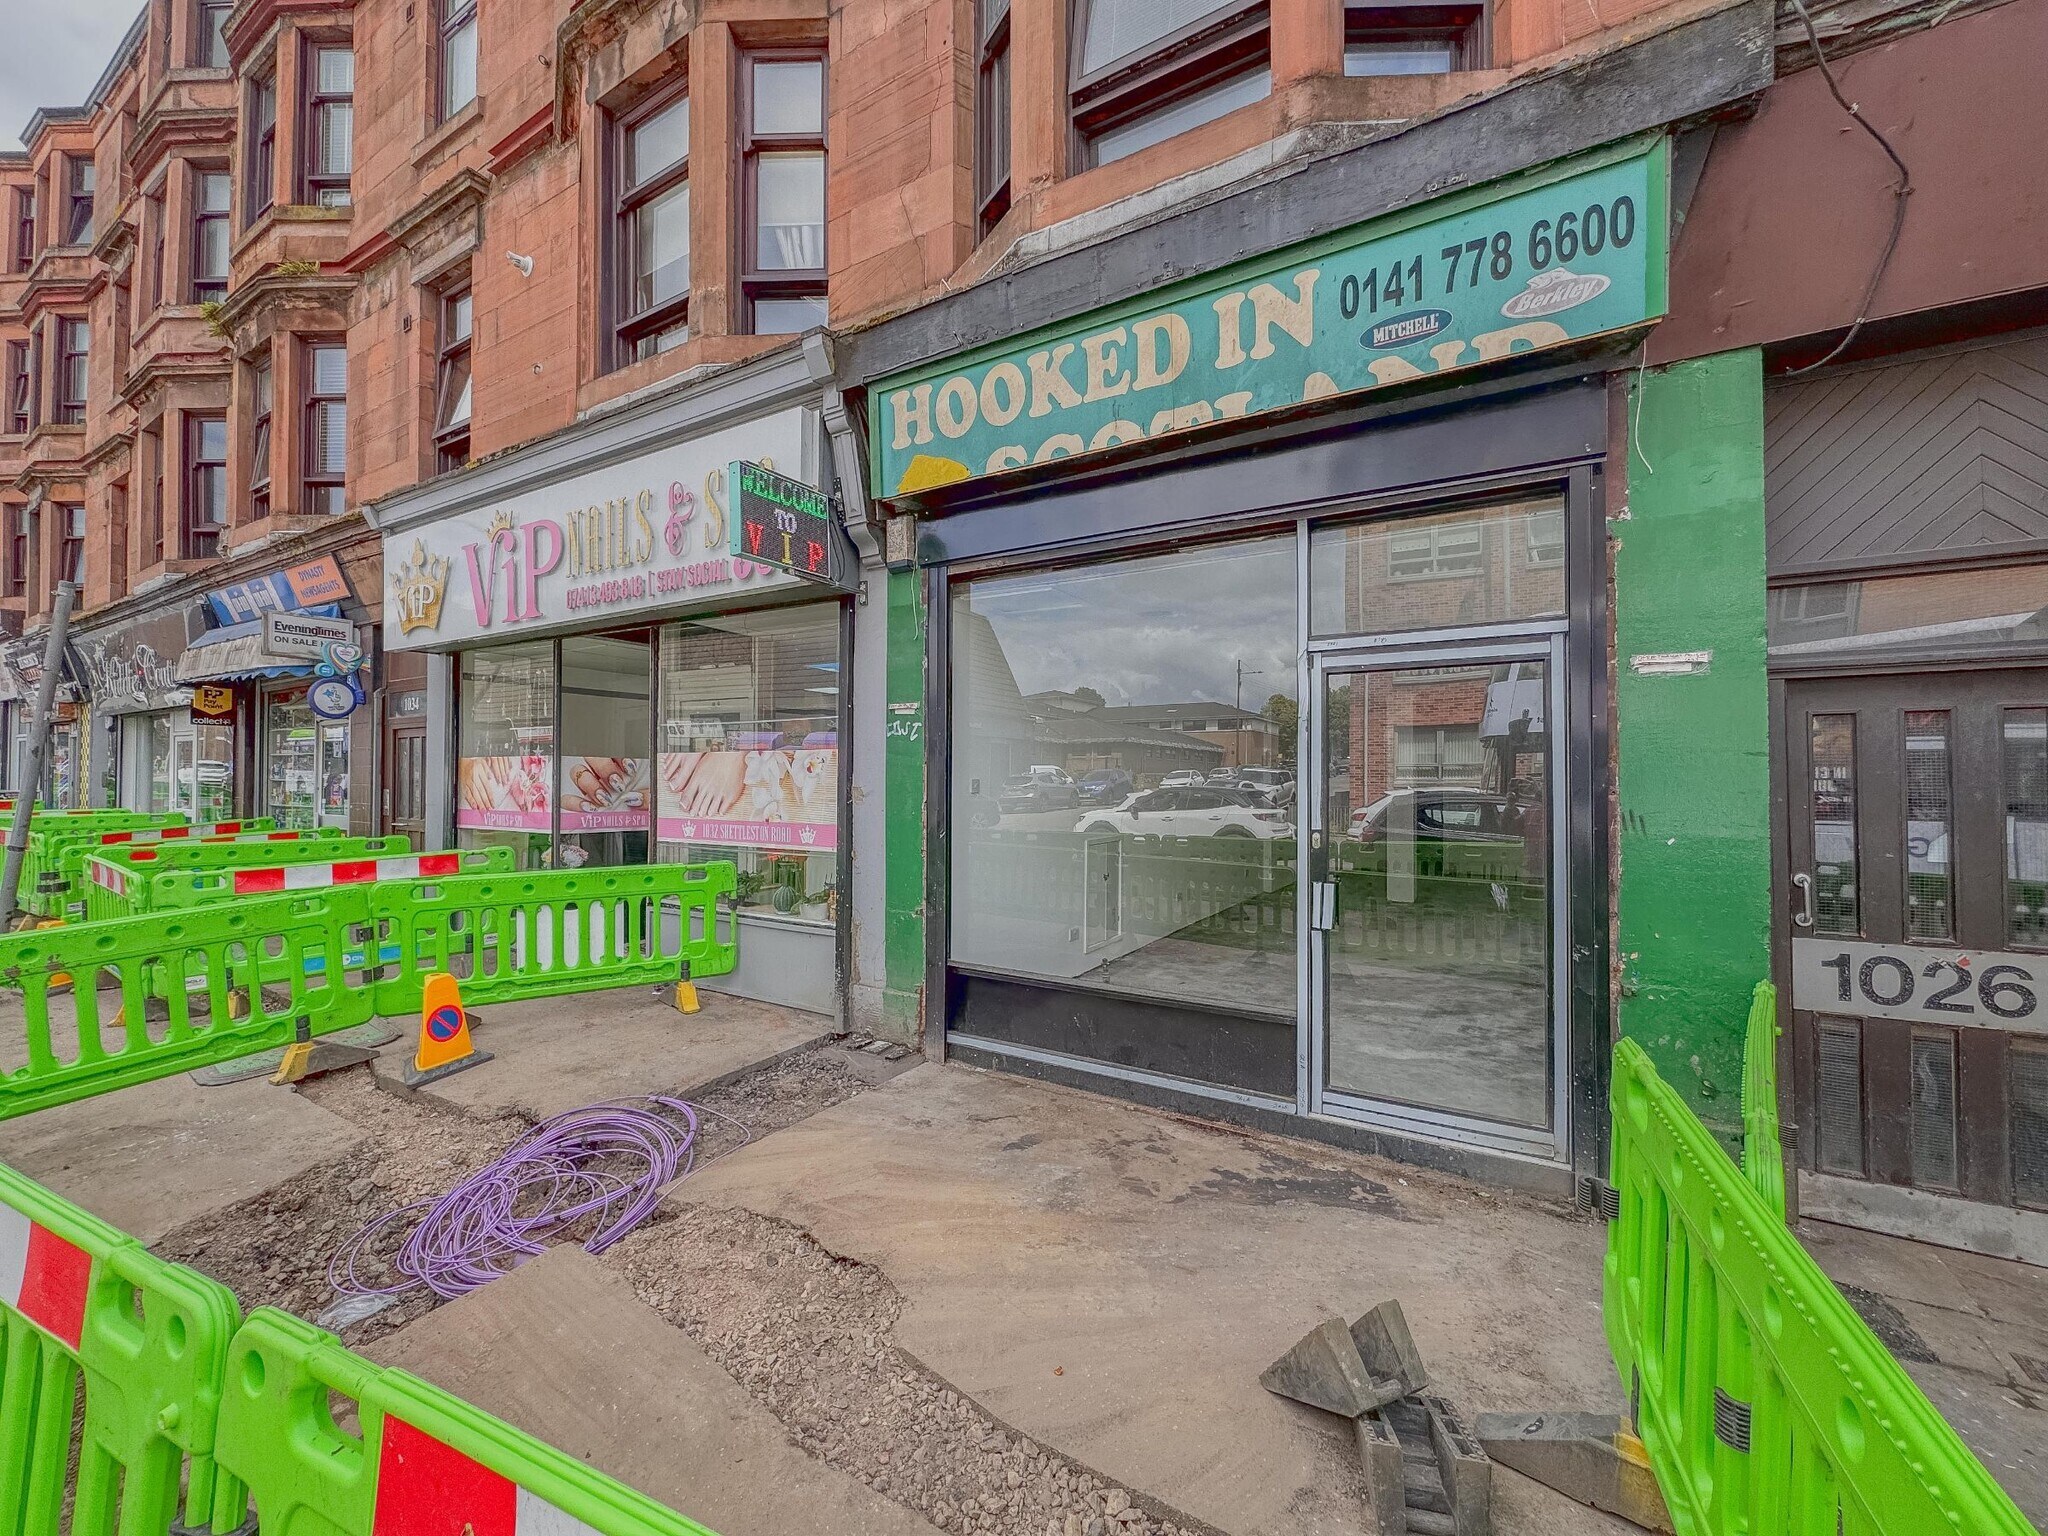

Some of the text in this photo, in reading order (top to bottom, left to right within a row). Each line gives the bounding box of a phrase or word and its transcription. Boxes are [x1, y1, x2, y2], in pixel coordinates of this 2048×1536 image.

[1340, 195, 1635, 320] 0141 778 6600
[1514, 279, 1598, 314] Berkley
[1373, 314, 1439, 343] MITCHELL
[890, 312, 1192, 450] HOOKED
[1213, 268, 1320, 370] IN
[742, 466, 829, 520] WELCOME
[566, 489, 654, 578] NAILS
[774, 508, 798, 534] TO
[298, 563, 326, 582] DYNASTY
[301, 580, 340, 599] NEWSAGENTS
[274, 635, 290, 644] ON
[292, 637, 318, 647] SALE
[602, 815, 623, 827] NAILS
[632, 814, 647, 826] SPA
[720, 824, 770, 841] SHETTLESTON
[771, 827, 792, 843] ROAD
[1821, 953, 2037, 1018] 1026
